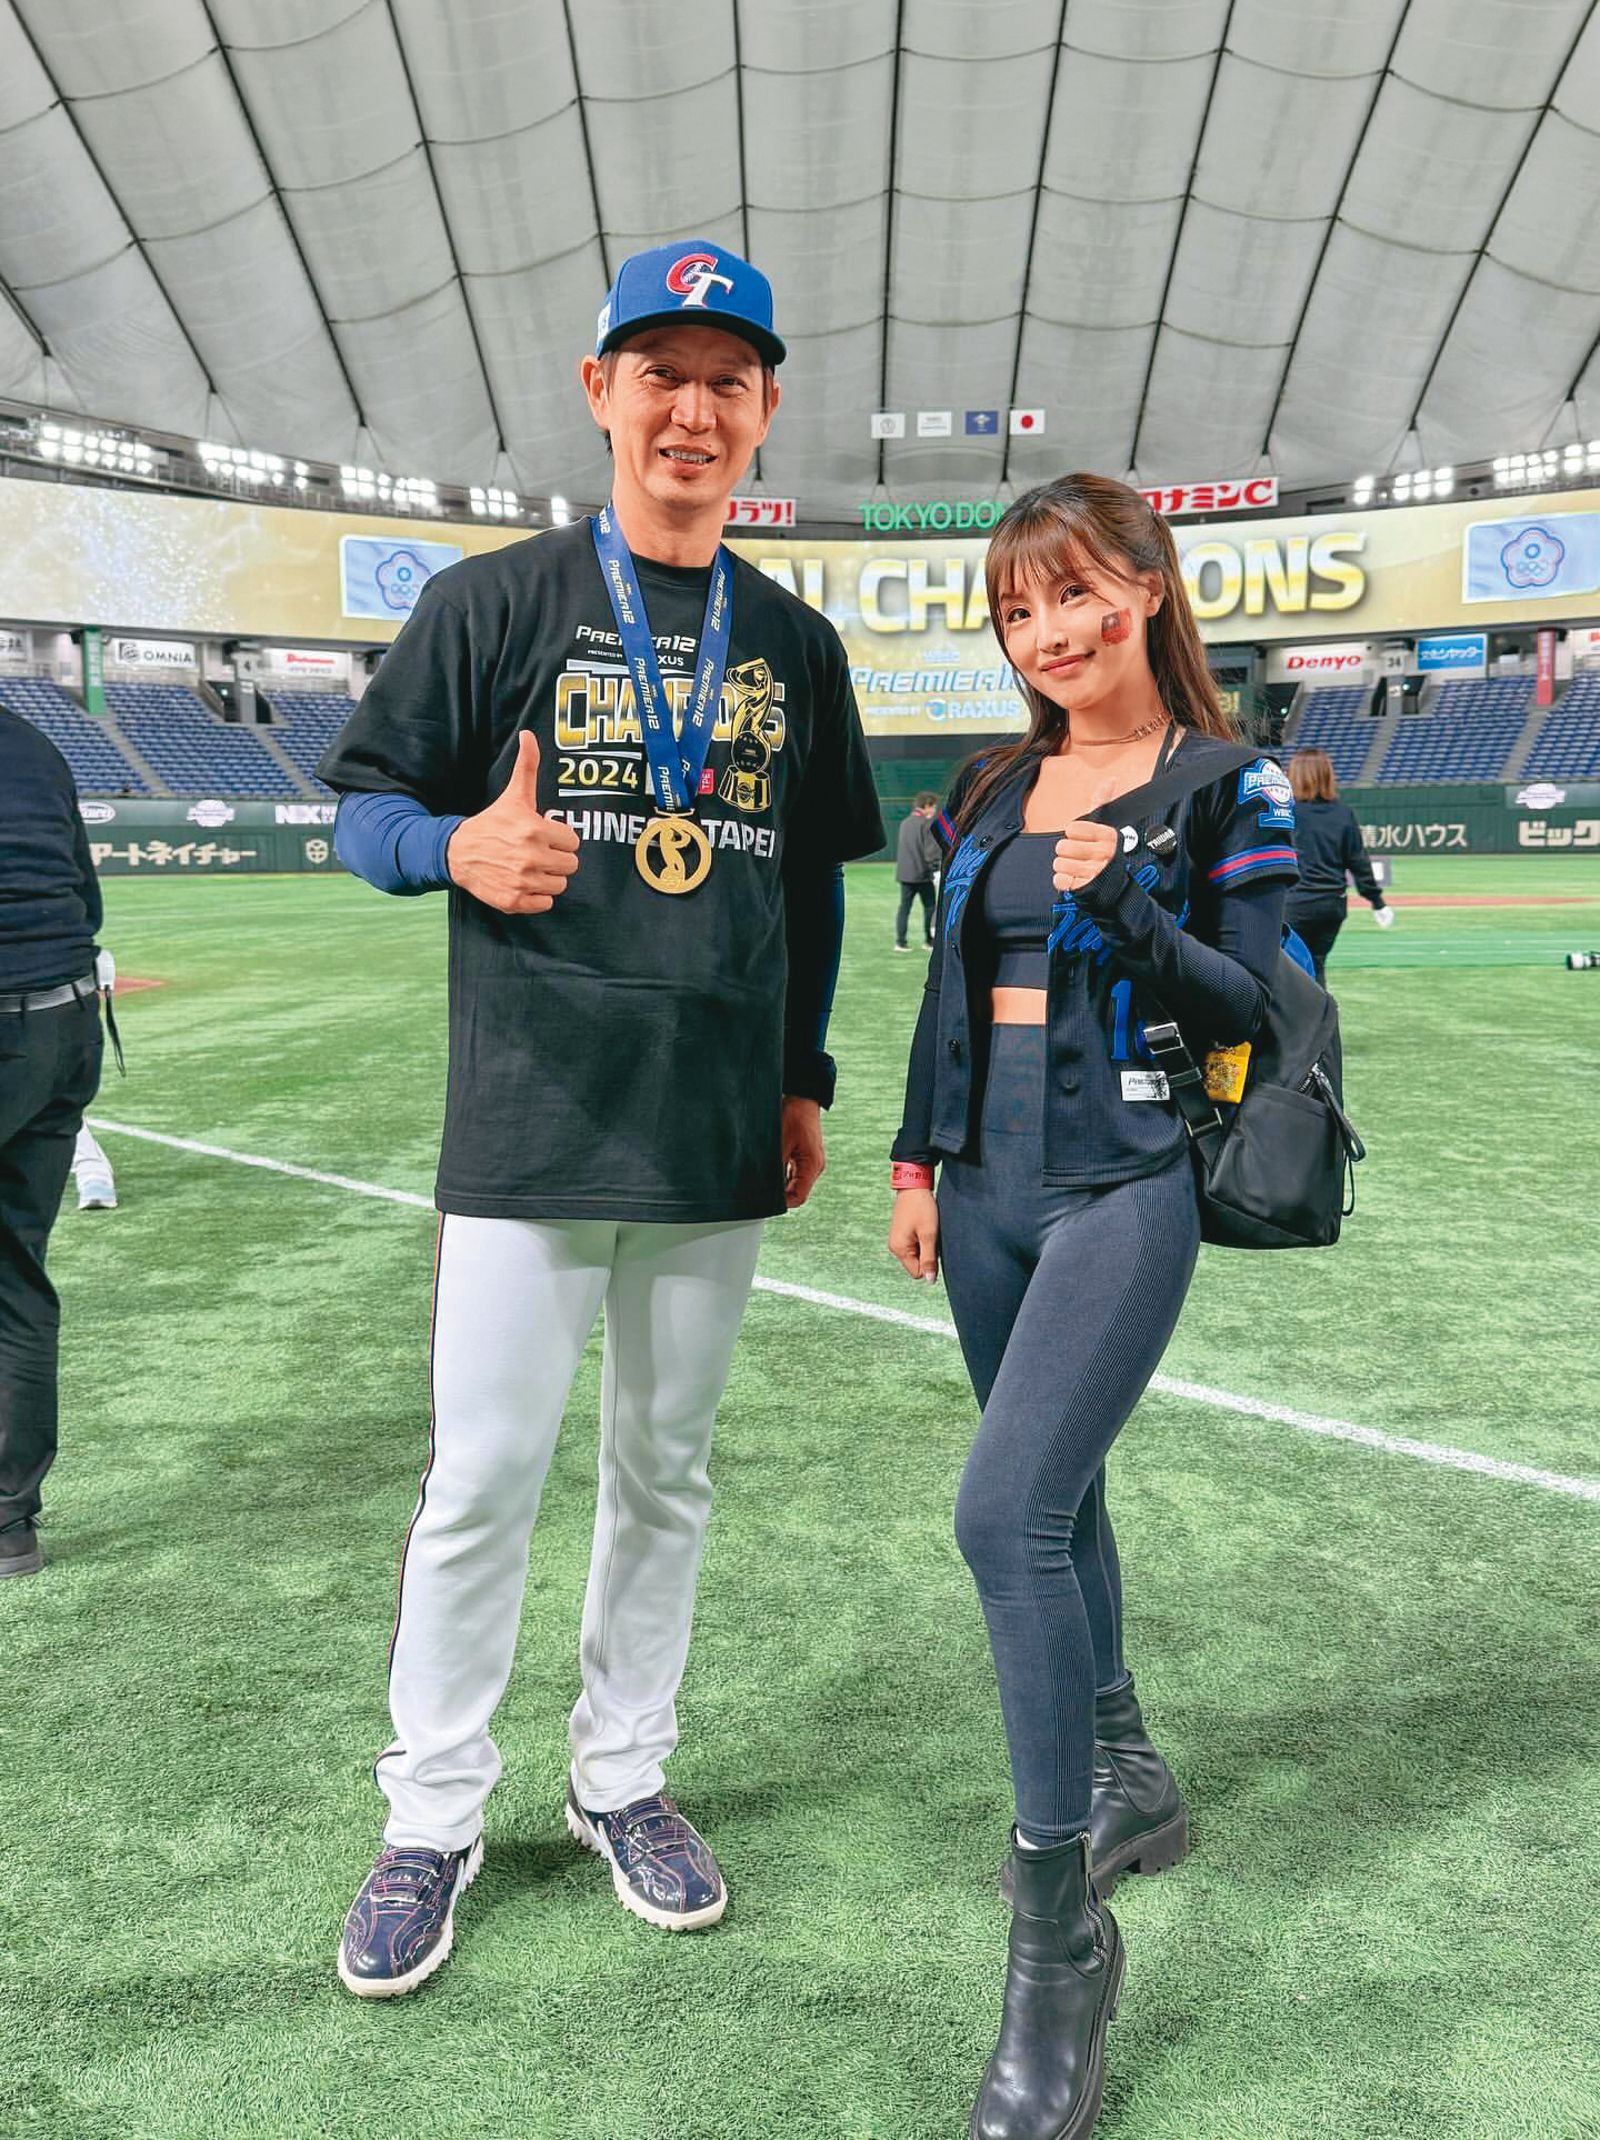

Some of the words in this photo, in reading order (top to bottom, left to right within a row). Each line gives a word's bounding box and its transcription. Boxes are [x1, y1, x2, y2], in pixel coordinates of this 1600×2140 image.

[860, 502, 952, 531] TOKYO
[608, 559, 635, 625] PREMIER12
[709, 567, 728, 632] PREMIER12
[144, 650, 192, 664] OMNIA
[658, 655, 684, 666] XUS
[1286, 654, 1362, 670] Denyo
[634, 656, 660, 731] PREMIER12
[692, 658, 715, 728] PREMIER12
[852, 664, 1014, 694] PREMIER1
[558, 757, 639, 789] 2024
[657, 766, 676, 811] PREMIE
